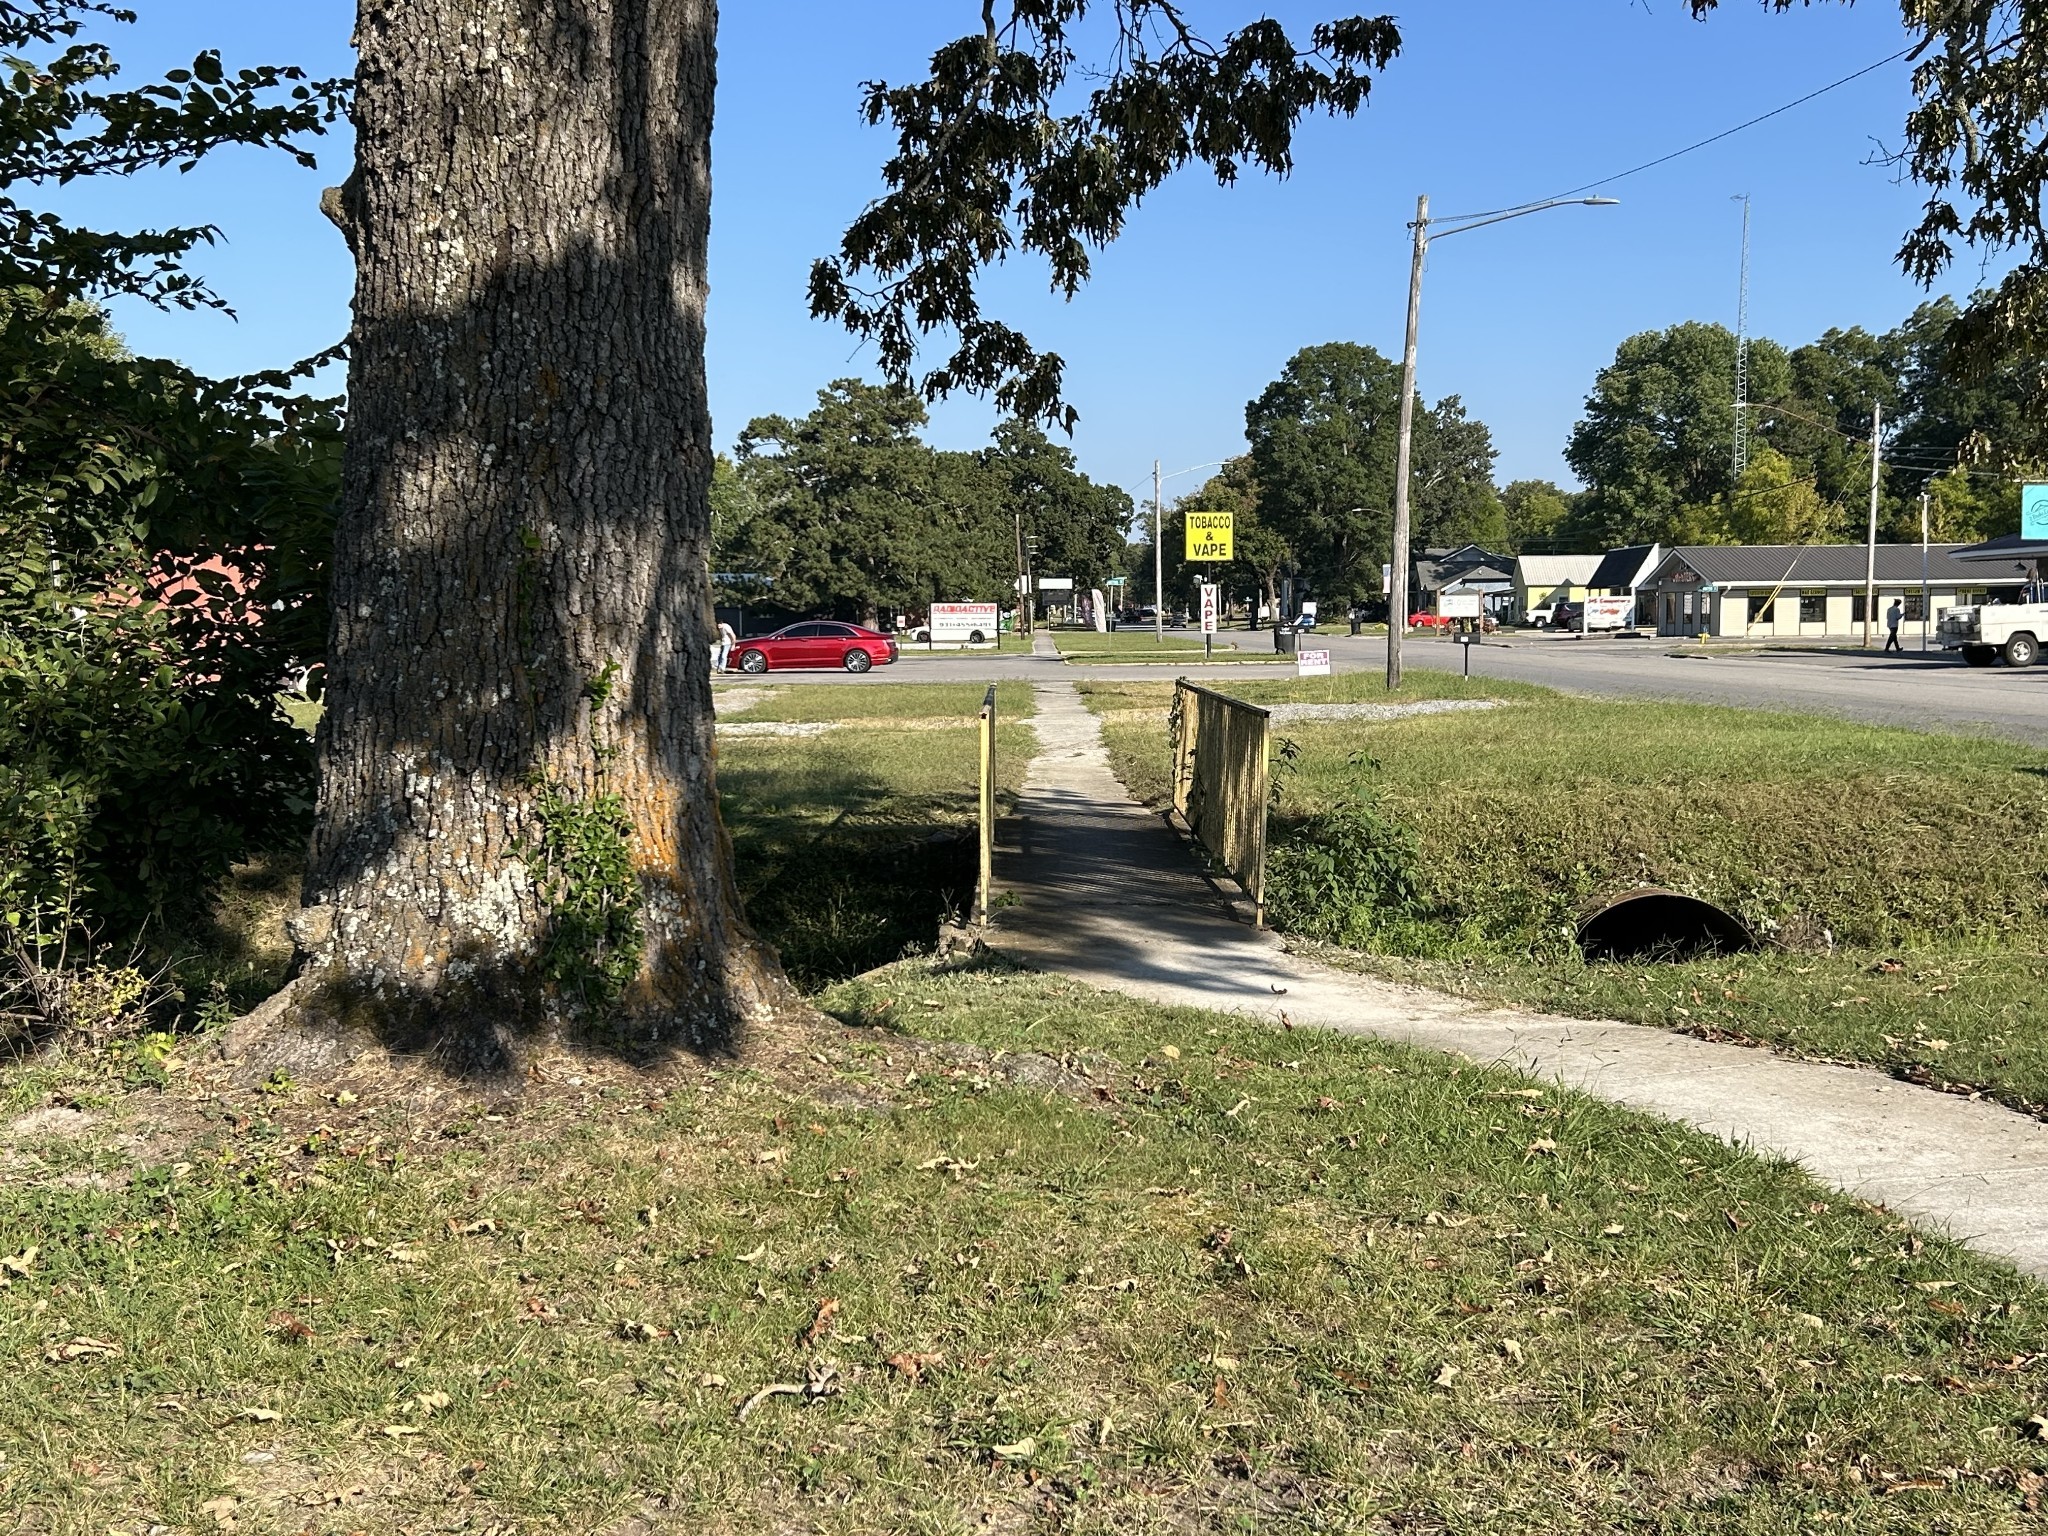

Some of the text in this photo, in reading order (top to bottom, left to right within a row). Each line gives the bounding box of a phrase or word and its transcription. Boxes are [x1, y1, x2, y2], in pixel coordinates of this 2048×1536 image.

[1190, 516, 1231, 529] TOBACCO
[1205, 531, 1214, 541] &
[1193, 543, 1227, 556] VAPE
[933, 605, 996, 613] RADIOACTIVE
[1204, 587, 1214, 631] VAPE
